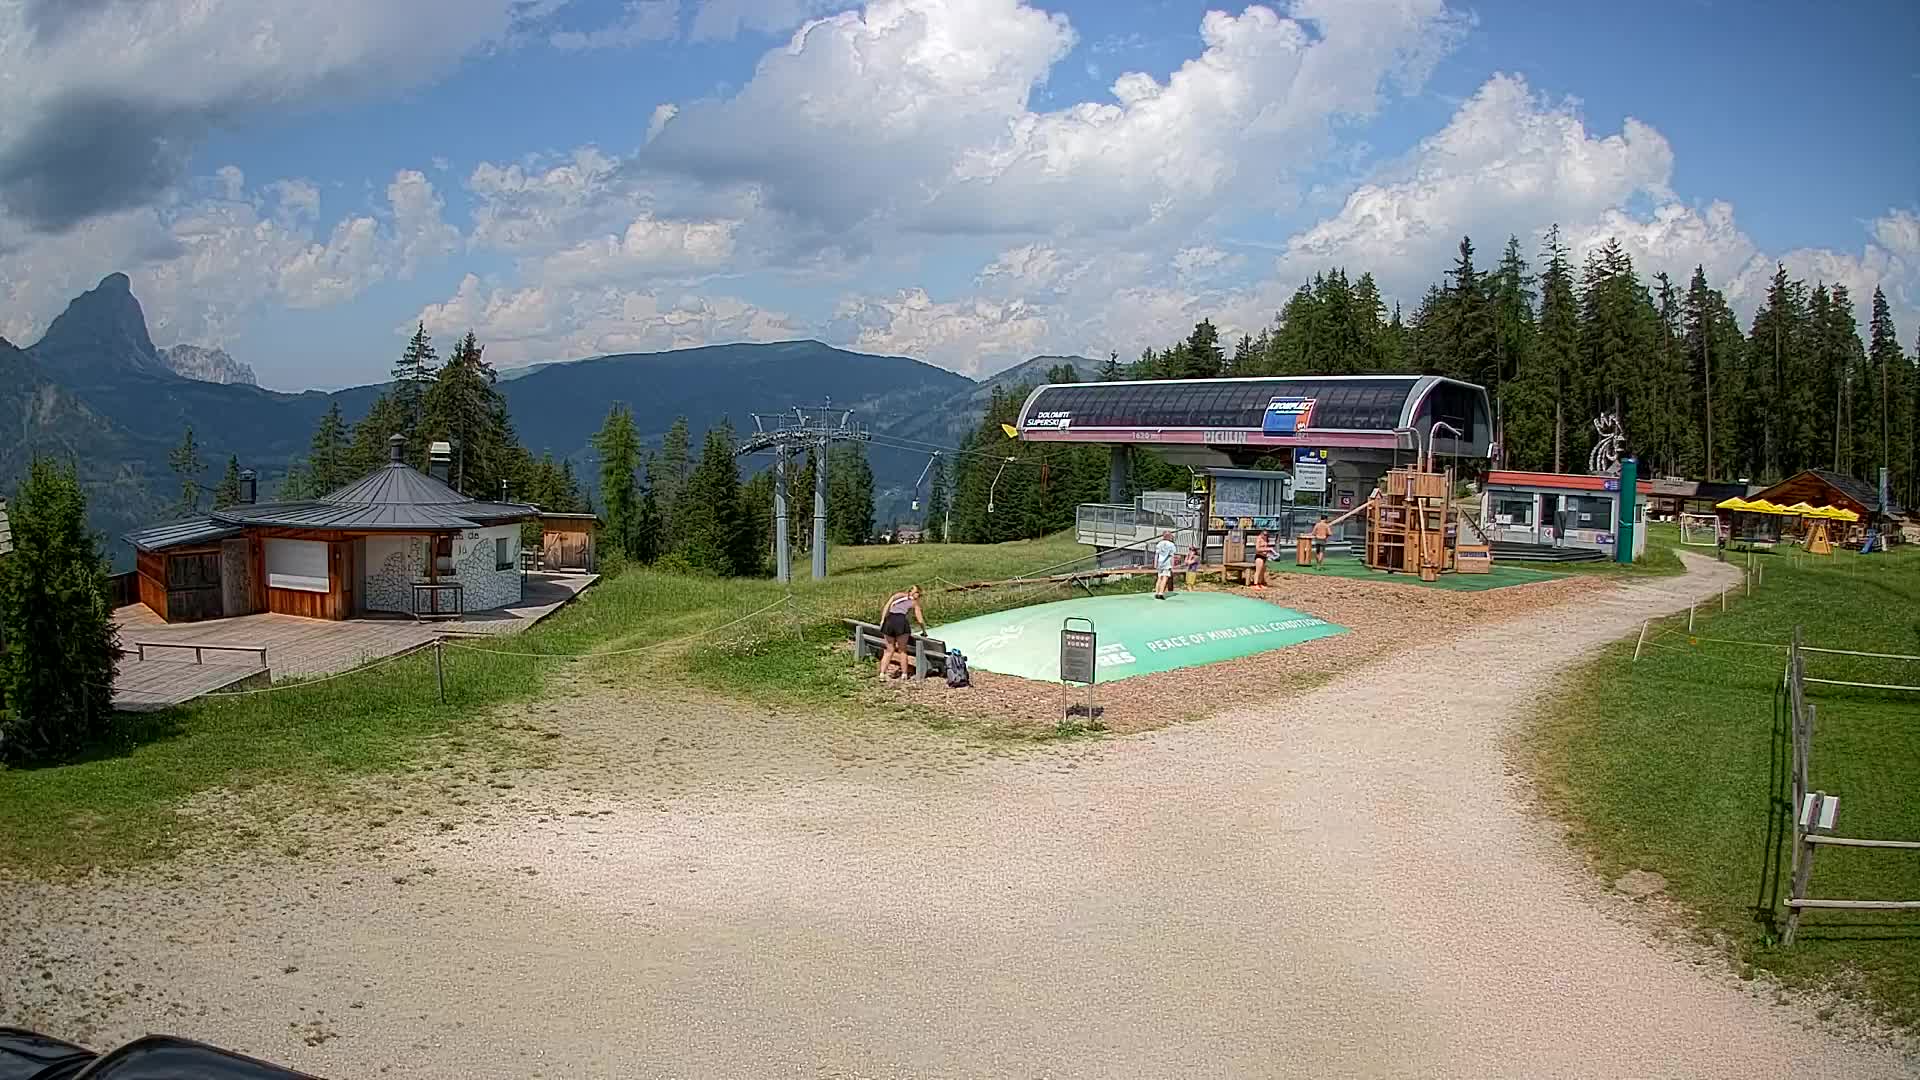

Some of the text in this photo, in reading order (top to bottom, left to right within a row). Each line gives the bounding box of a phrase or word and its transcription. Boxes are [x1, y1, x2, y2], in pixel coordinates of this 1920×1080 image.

[1132, 431, 1150, 439] 1620
[1203, 431, 1247, 443] PICULIN
[1146, 635, 1190, 652] PEACE
[1190, 633, 1207, 644] OF
[1207, 629, 1237, 640] MIND
[1237, 627, 1250, 637] IN
[1251, 624, 1272, 633] ALL
